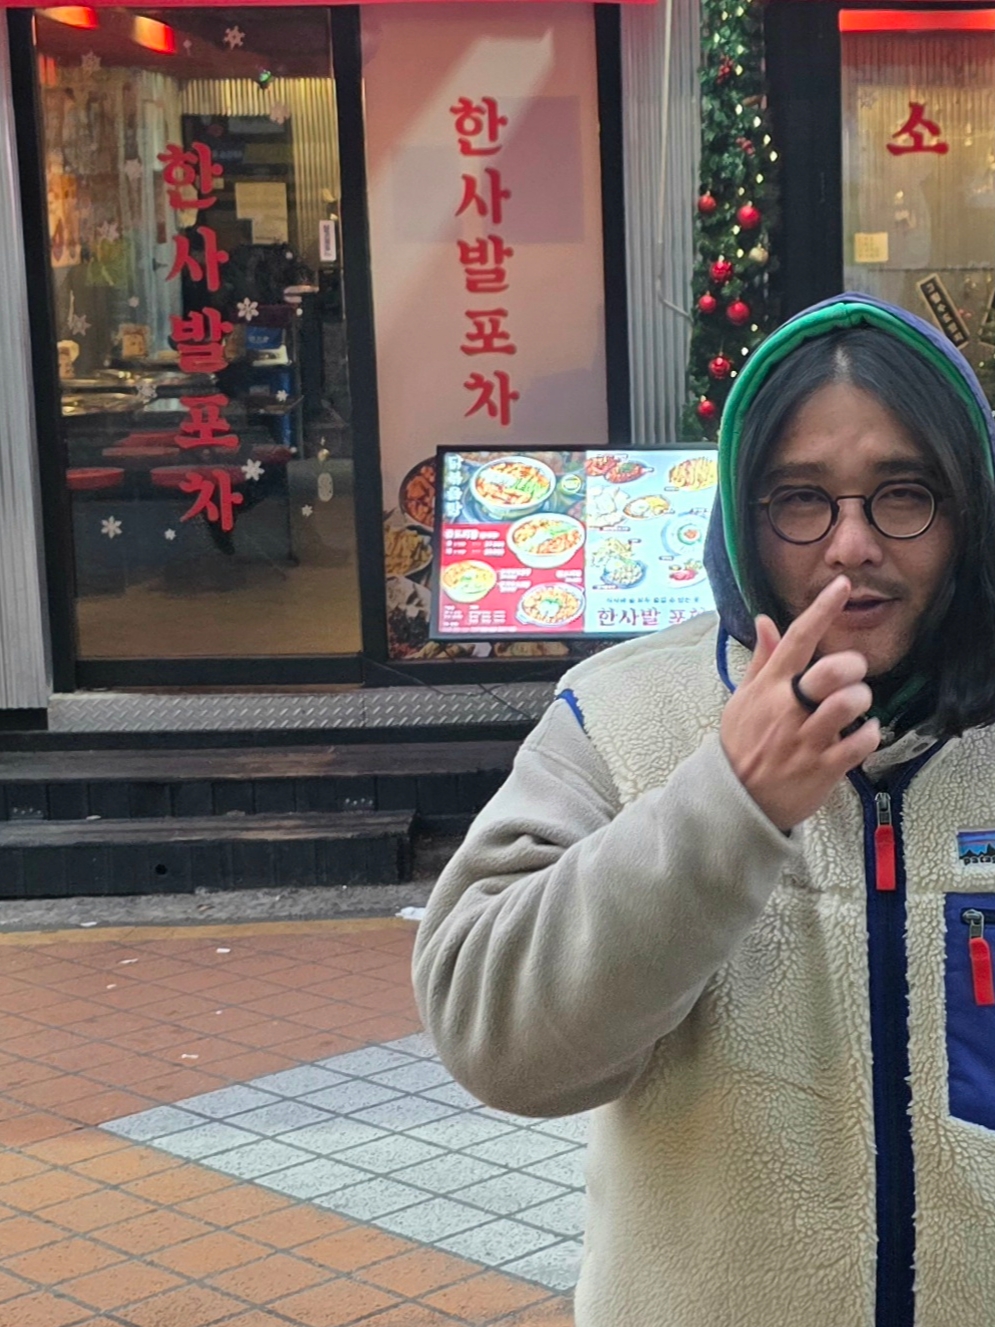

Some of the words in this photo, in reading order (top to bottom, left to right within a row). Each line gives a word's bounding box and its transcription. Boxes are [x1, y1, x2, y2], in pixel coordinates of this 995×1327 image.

[157, 141, 243, 532] 한사발포차
[449, 96, 520, 426] 한사발포차
[597, 607, 661, 626] 한사발
